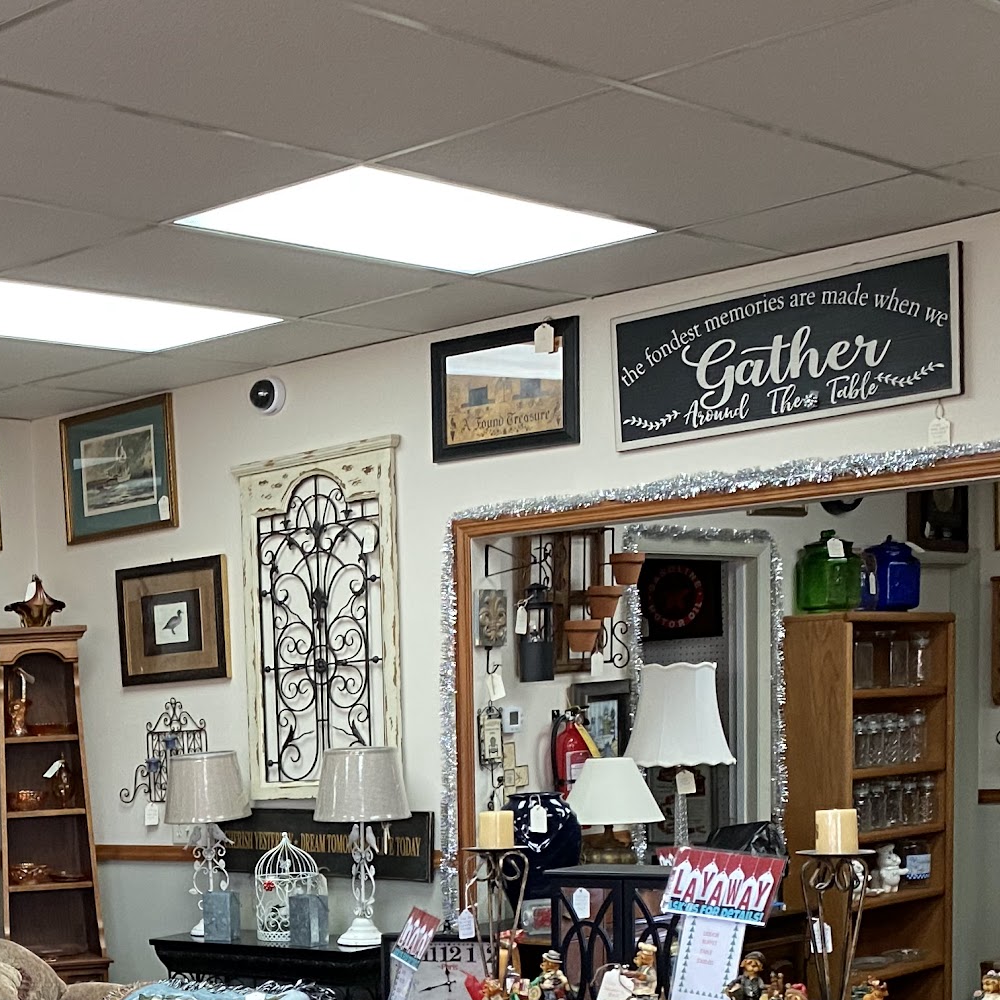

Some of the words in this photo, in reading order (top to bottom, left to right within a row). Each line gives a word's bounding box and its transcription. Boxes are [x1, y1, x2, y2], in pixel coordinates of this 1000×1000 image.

[621, 362, 646, 387] the
[645, 323, 702, 367] fondest
[705, 295, 785, 334] memories
[790, 292, 816, 308] are
[821, 283, 869, 306] made
[874, 288, 921, 317] when
[925, 306, 949, 328] we
[681, 325, 891, 409] Gather
[683, 394, 749, 429] Around
[767, 385, 803, 415] The
[826, 372, 878, 405] Table
[462, 419, 471, 433] A
[506, 410, 551, 426] Treasure
[649, 604, 685, 628] MOTOR
[688, 602, 702, 620] OIL
[254, 832, 294, 851] YESTERY
[301, 833, 326, 853] DREAM
[377, 837, 394, 856] LIE
[395, 837, 421, 857] TODAY
[673, 869, 770, 910] LAYAWAY
[700, 904, 720, 916] FOR
[440, 946, 461, 962] 12
[467, 947, 476, 962] 1
